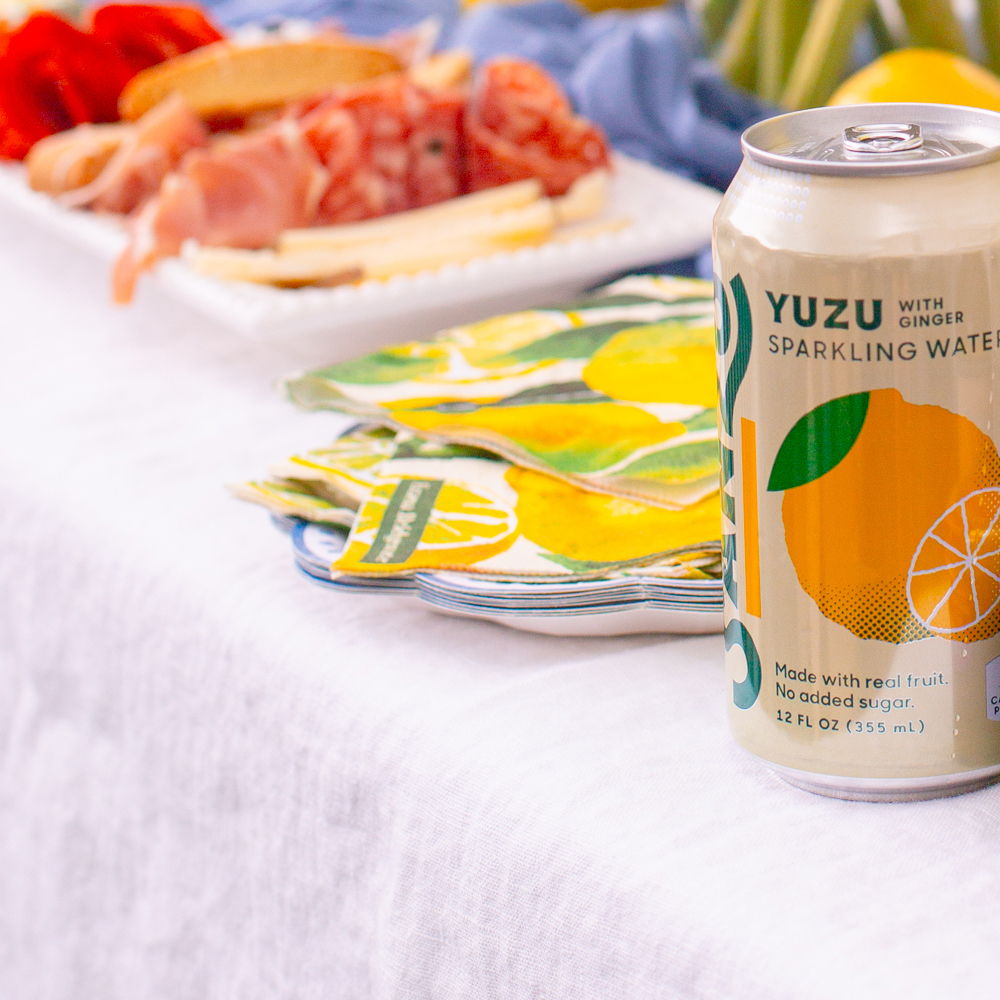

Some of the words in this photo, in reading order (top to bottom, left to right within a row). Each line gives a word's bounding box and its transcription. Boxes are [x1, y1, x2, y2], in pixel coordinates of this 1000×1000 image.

[765, 290, 883, 330] YUZU
[899, 298, 944, 313] WITH
[899, 312, 964, 328] GINGER
[768, 334, 917, 361] SPARKLING
[775, 662, 817, 685] Made
[822, 672, 860, 689] with
[865, 672, 901, 689] real
[907, 672, 949, 689] fruit.
[776, 682, 795, 700] No
[800, 690, 854, 709] added
[859, 694, 915, 713] sugar.
[776, 709, 792, 724] 12
[797, 714, 813, 728] FL
[818, 719, 839, 732] OZ
[845, 720, 886, 735] (355
[894, 719, 925, 735] mL)
